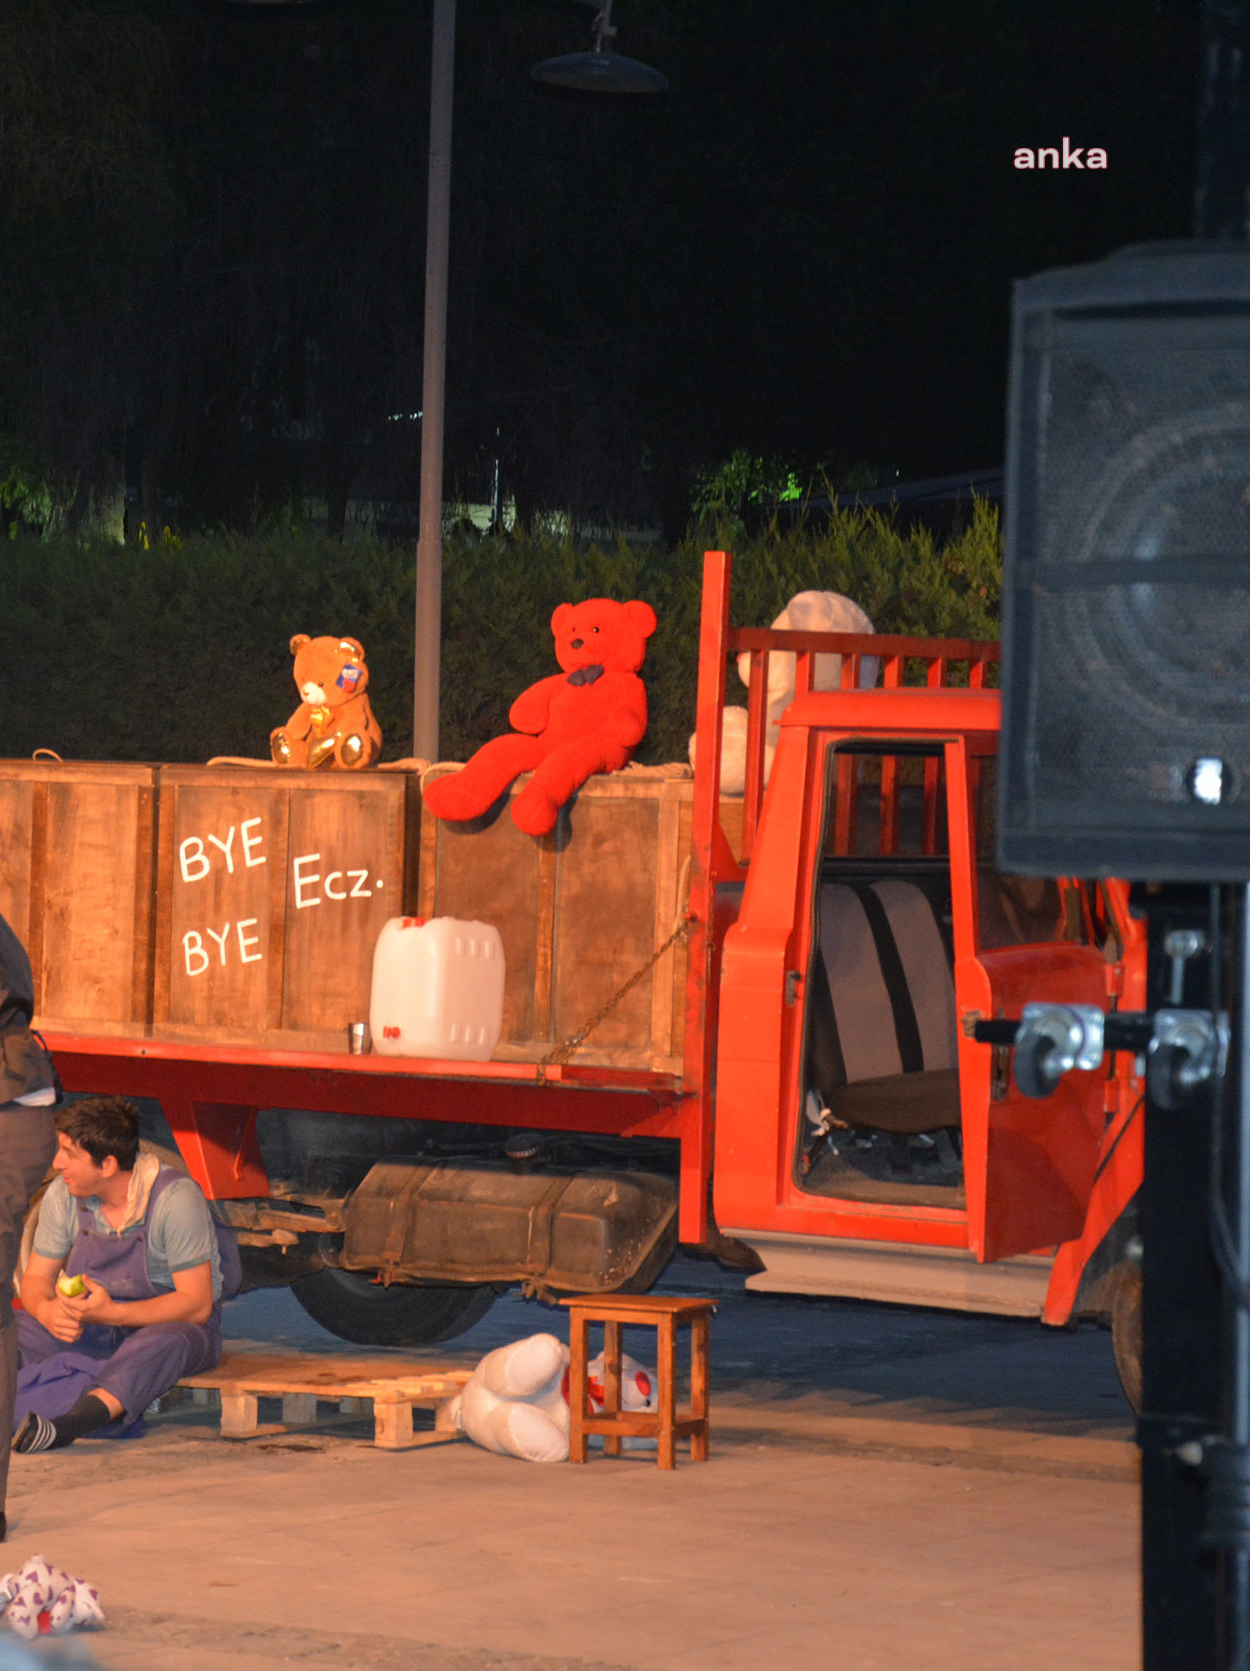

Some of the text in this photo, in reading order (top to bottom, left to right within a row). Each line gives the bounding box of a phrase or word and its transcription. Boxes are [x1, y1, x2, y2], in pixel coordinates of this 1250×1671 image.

[179, 817, 267, 883] BYE
[293, 853, 383, 909] Ecz.
[182, 918, 263, 976] BYE
